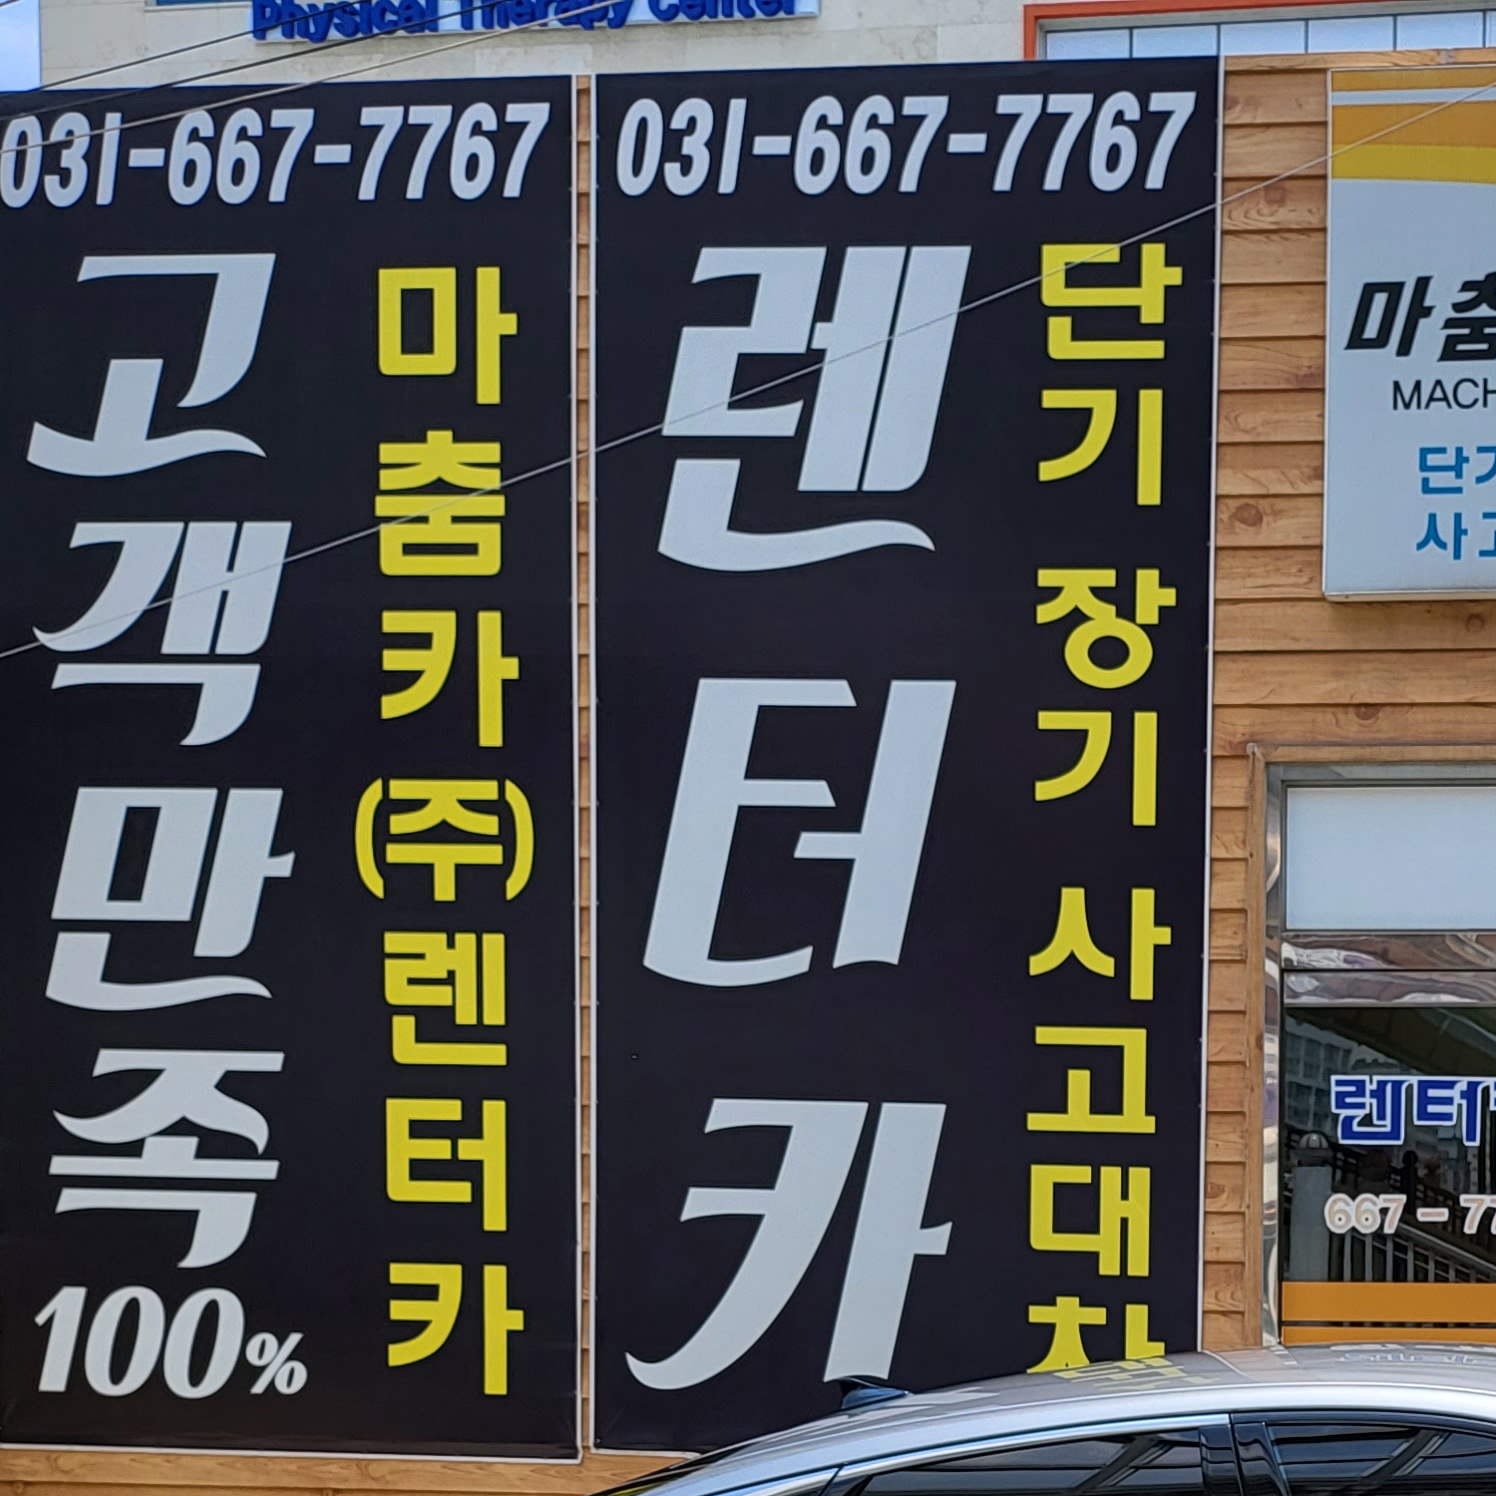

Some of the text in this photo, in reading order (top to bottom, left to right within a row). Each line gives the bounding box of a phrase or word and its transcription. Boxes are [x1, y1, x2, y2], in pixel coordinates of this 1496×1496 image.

[0, 101, 550, 208] 031-667-7767
[617, 91, 1196, 196] 031-667-7767
[626, 246, 972, 1390] 렌터카
[34, 1286, 308, 1399] 100%
